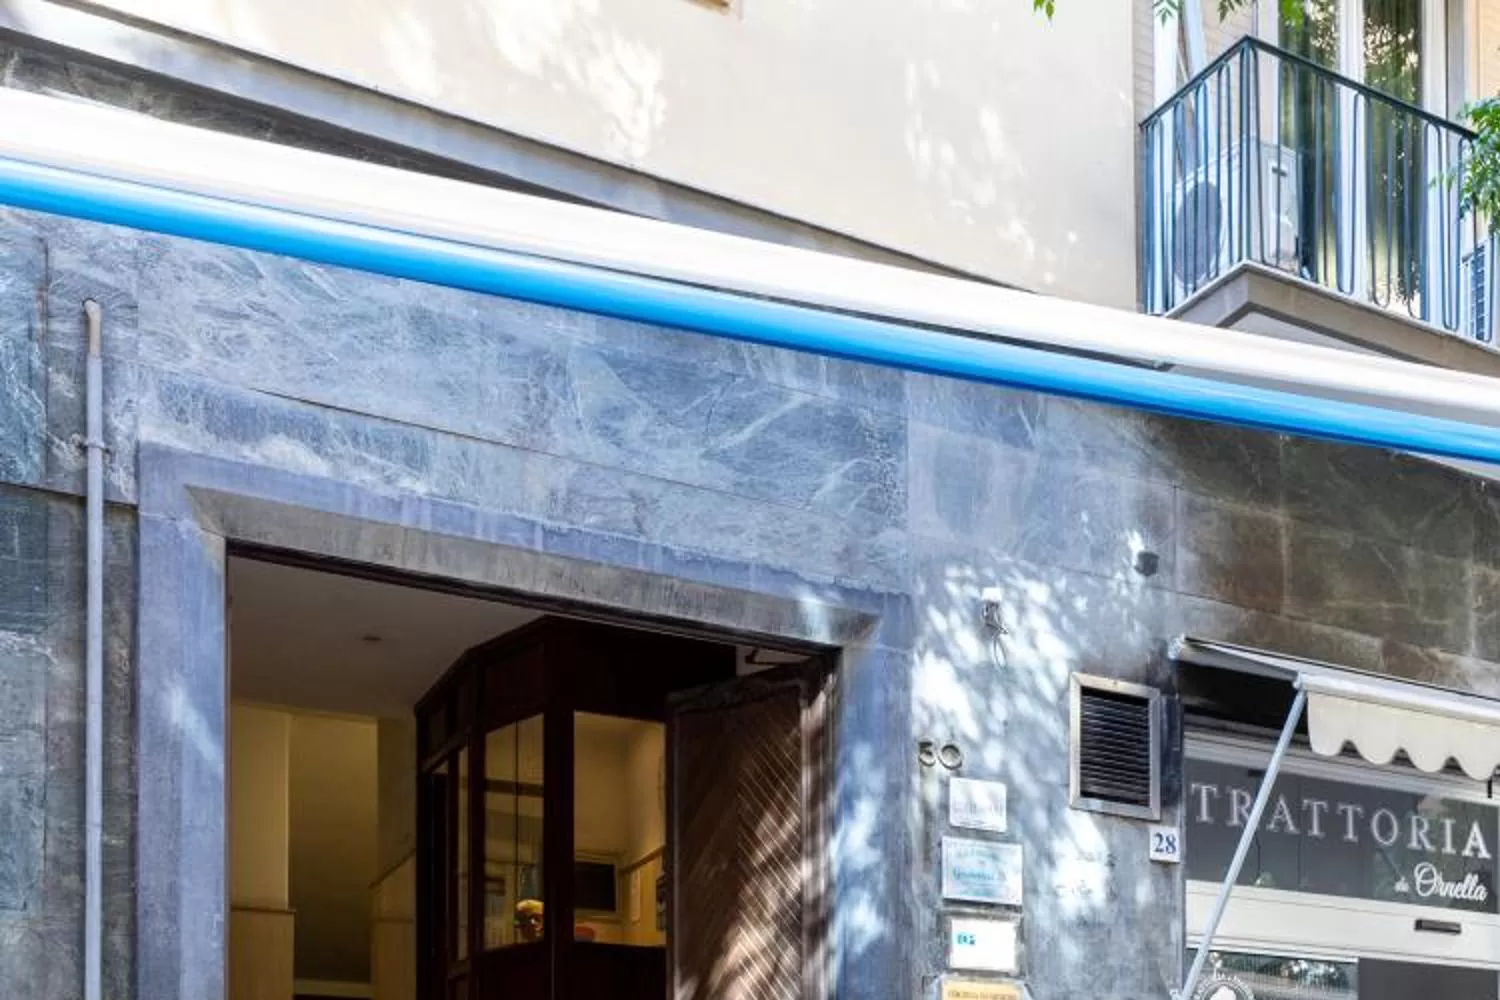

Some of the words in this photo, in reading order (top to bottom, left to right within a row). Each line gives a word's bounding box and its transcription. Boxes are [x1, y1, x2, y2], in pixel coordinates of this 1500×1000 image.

[1192, 782, 1492, 860] TRATTORIA
[1153, 832, 1177, 854] 28
[1413, 861, 1488, 902] Ornella
